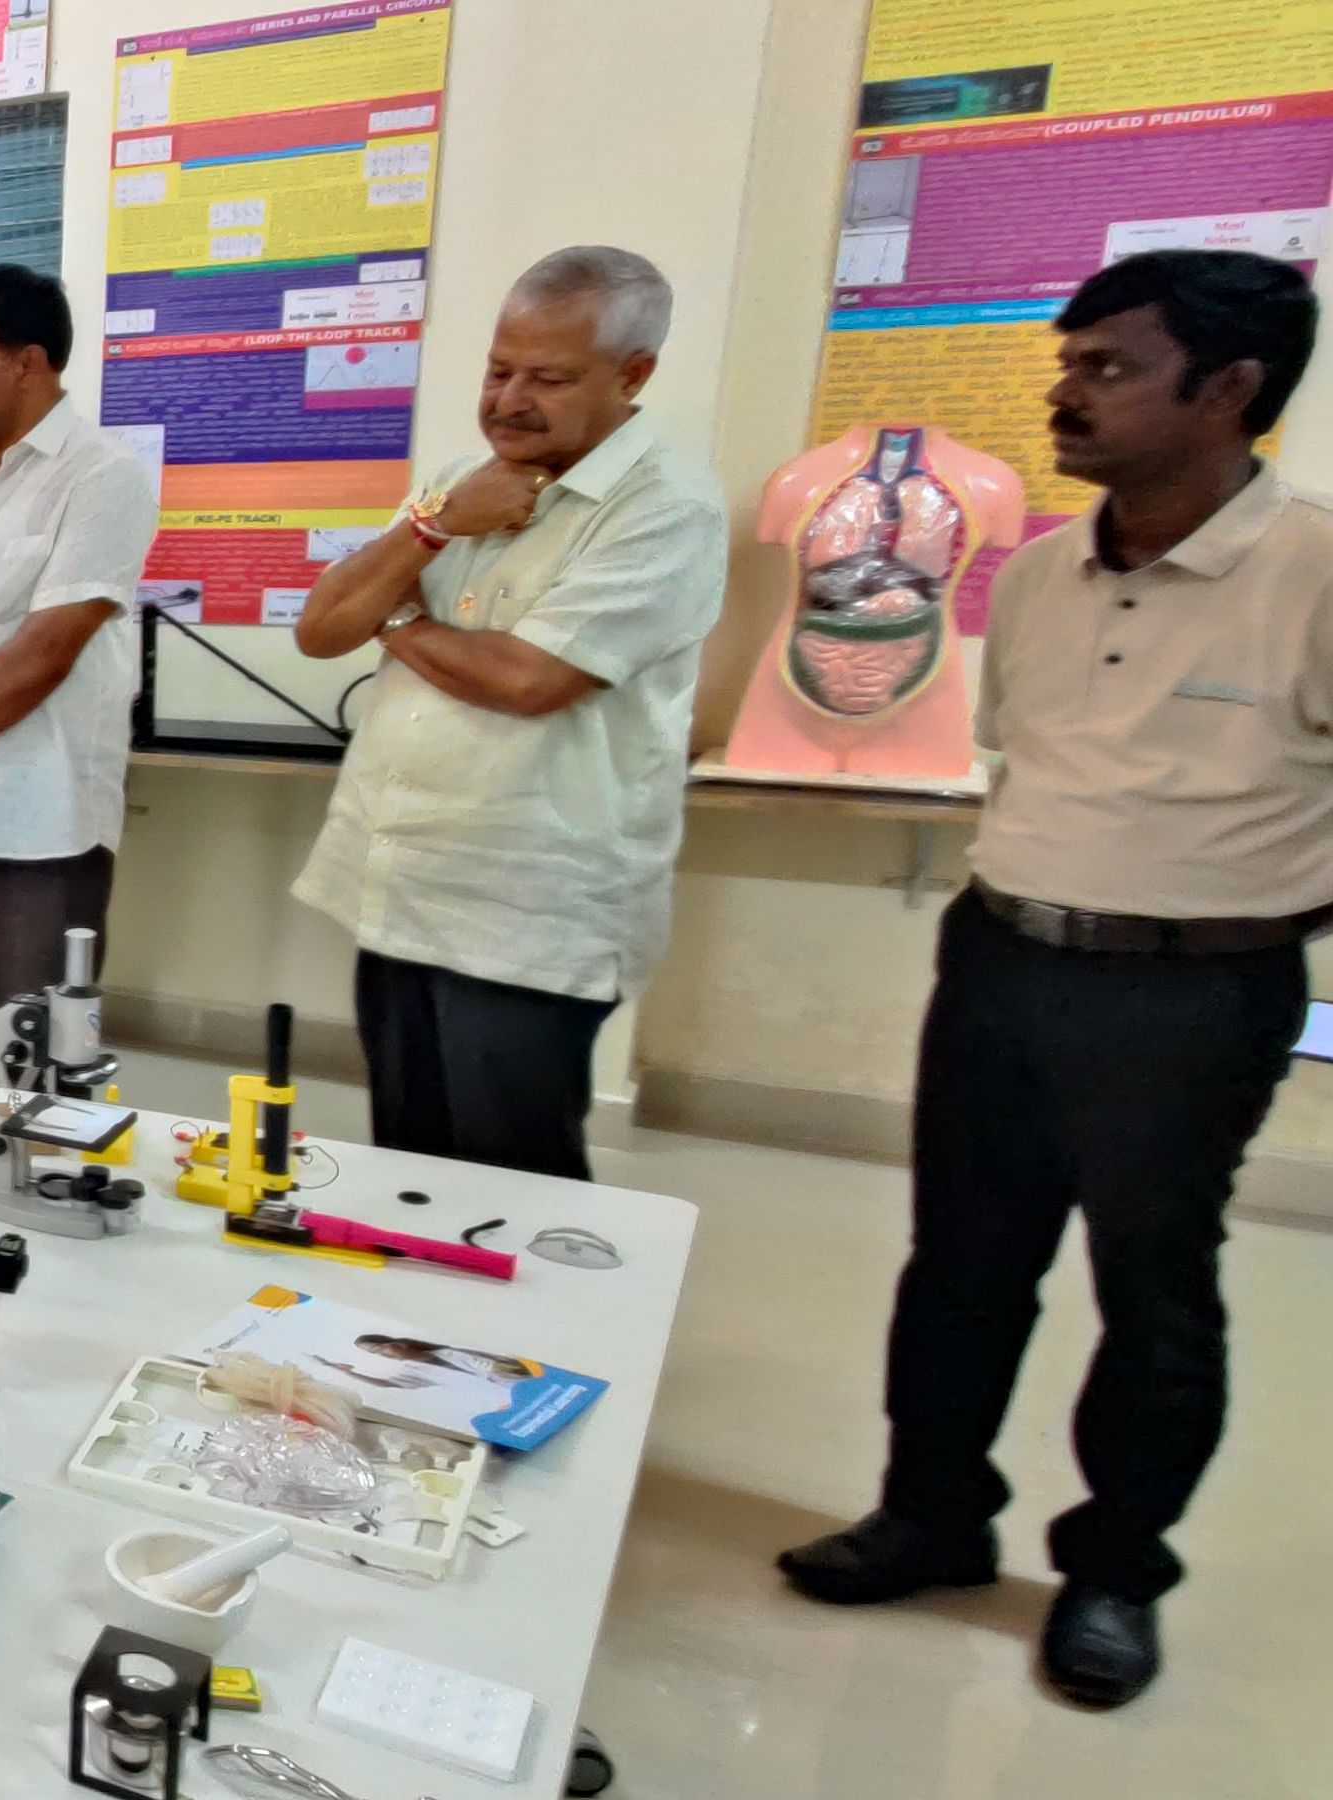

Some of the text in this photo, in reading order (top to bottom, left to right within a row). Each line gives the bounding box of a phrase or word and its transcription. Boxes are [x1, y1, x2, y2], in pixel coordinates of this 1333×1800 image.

[296, 14, 321, 25] AND
[323, 5, 382, 21] PARALLEL
[1045, 103, 1275, 137] (COUPLED PENDULUM)
